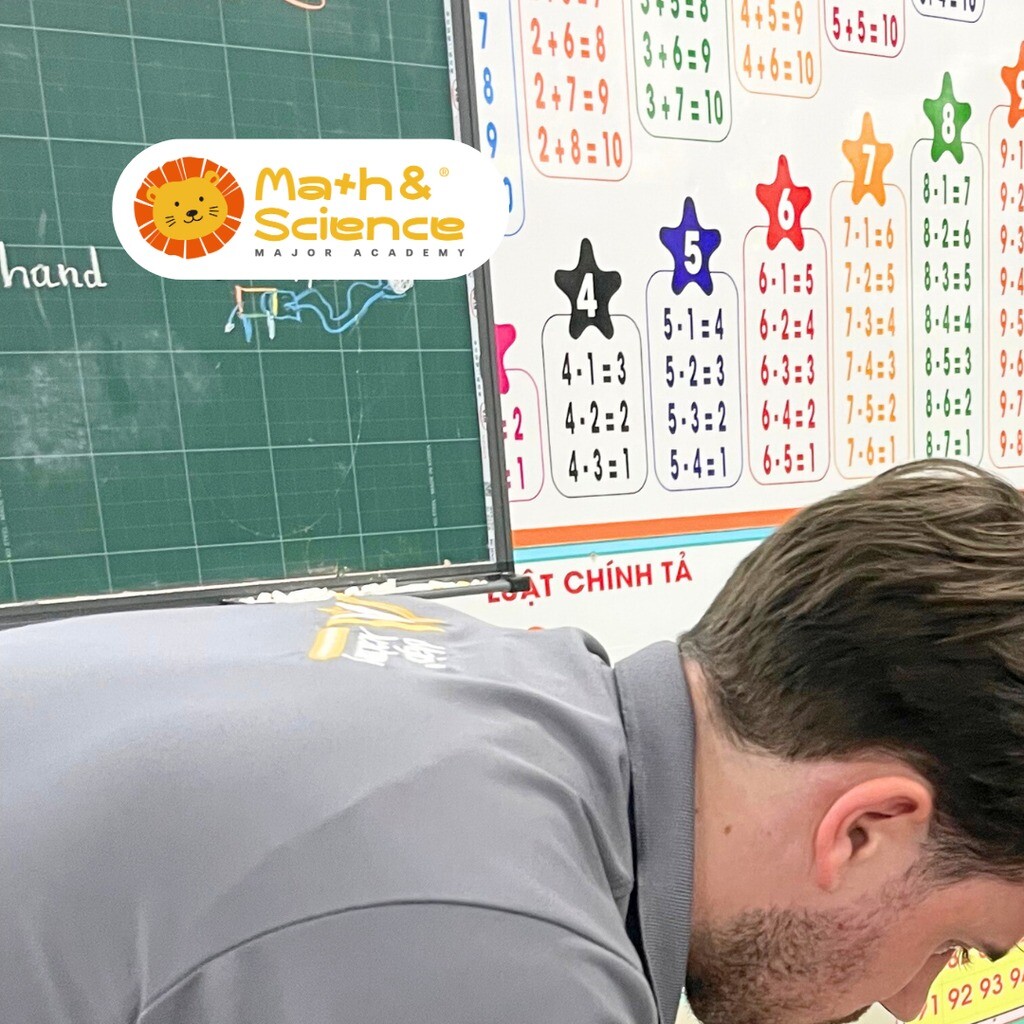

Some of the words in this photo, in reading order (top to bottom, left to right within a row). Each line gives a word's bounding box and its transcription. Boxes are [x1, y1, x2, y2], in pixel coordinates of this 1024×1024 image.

[941, 102, 956, 144] 8
[862, 144, 876, 185] 7
[777, 188, 795, 230] 6
[0, 241, 107, 289] hand
[684, 230, 702, 275] 5
[576, 272, 598, 318] 4
[563, 560, 652, 595] CHÍNH
[661, 551, 693, 583] TẢ
[948, 983, 973, 1010] 92
[980, 973, 1003, 1000] 93
